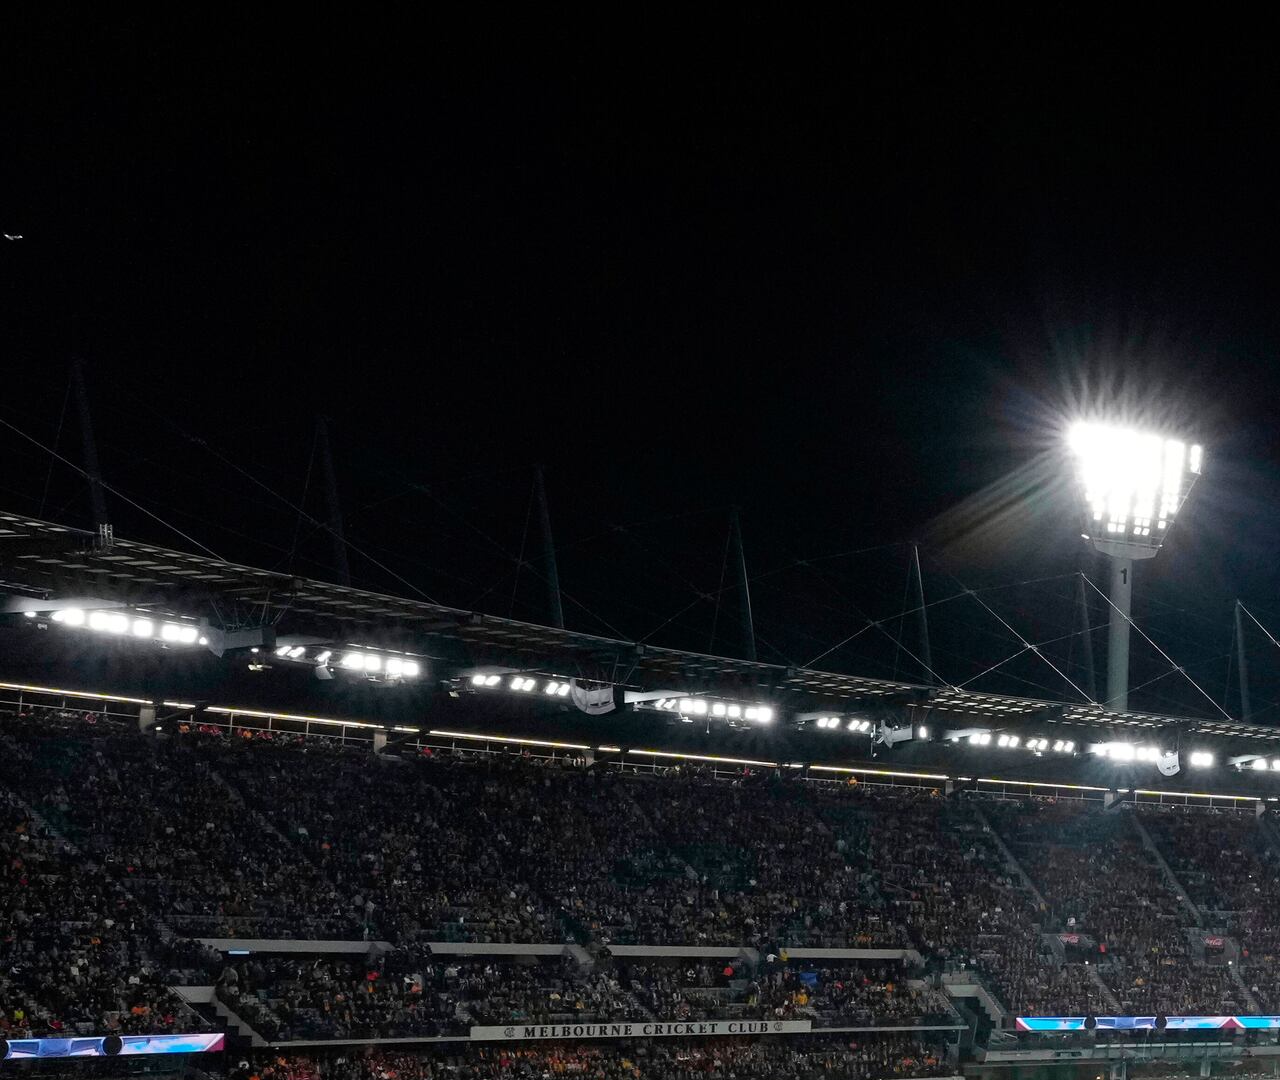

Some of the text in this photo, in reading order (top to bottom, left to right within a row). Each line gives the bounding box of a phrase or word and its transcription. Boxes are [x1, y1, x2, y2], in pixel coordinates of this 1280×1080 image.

[523, 1021, 769, 1038] MELBOURNE CRICKET CLUB
